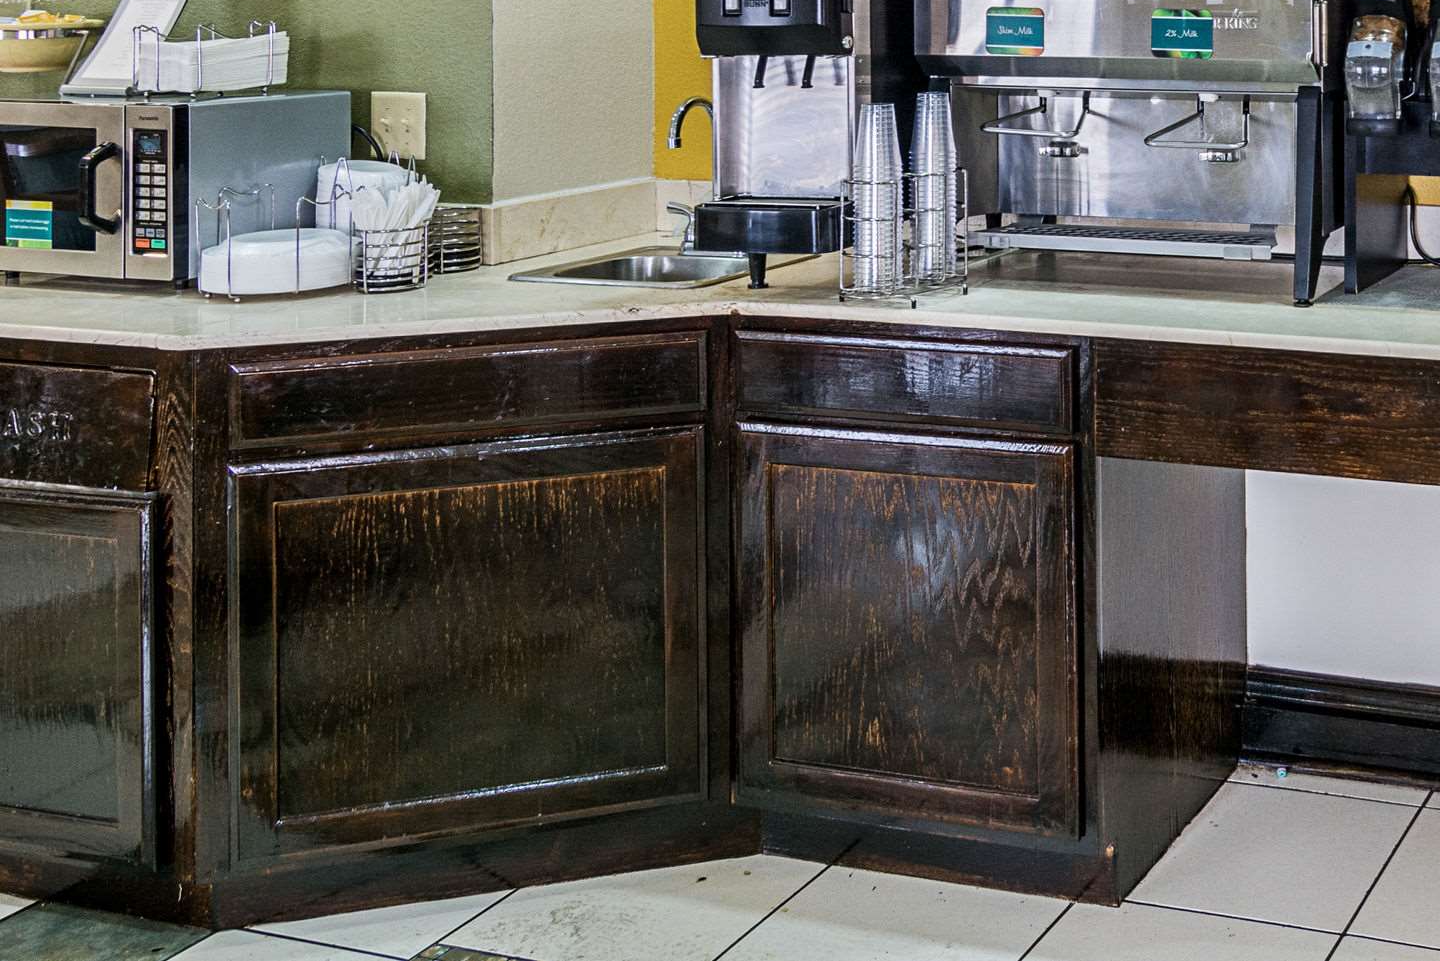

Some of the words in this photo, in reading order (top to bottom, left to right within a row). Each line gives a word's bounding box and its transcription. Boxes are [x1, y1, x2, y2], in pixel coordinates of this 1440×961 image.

[1224, 17, 1258, 30] KING
[1164, 29, 1177, 38] 2%
[1178, 28, 1199, 39] Milk
